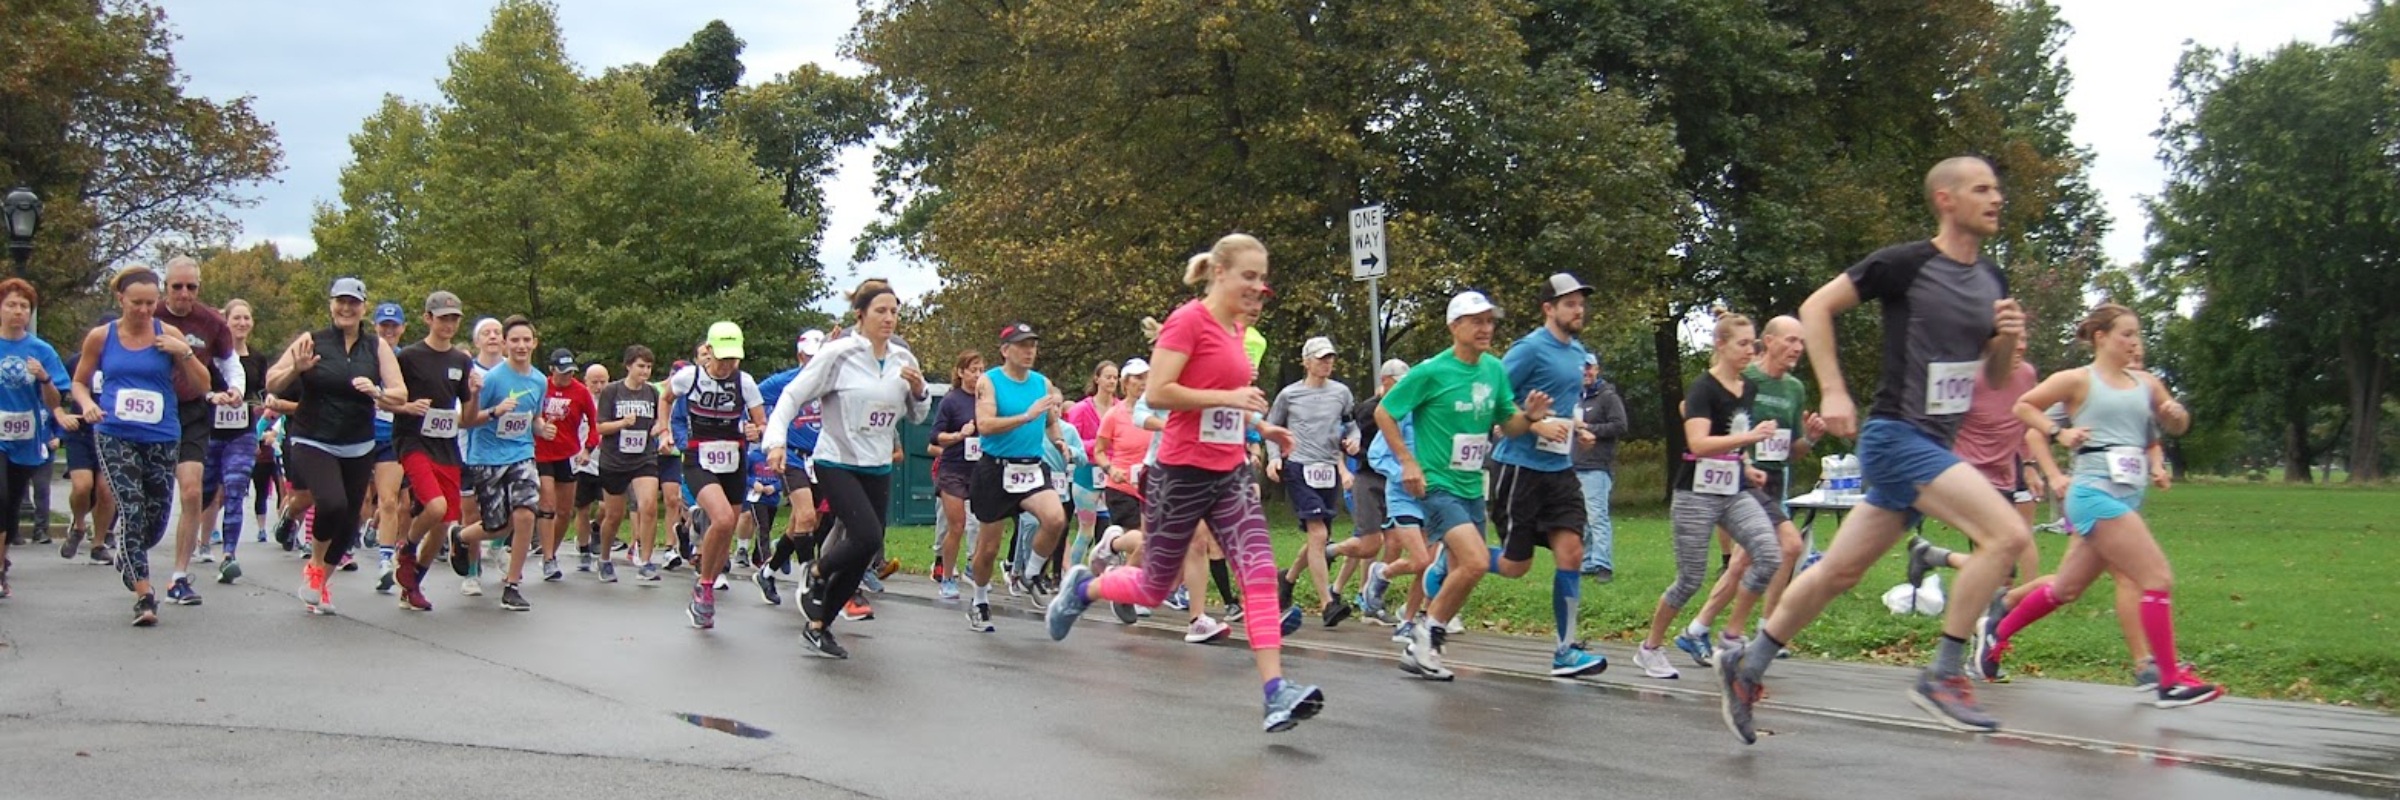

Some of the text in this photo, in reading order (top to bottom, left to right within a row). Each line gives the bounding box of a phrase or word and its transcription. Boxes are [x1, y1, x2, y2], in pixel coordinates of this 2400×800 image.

[1354, 210, 1378, 229] ONE
[1355, 231, 1379, 250] WAY
[125, 398, 155, 415] 953
[219, 411, 247, 422] 1014
[431, 417, 454, 431] 903
[870, 411, 895, 427] 937
[1212, 410, 1241, 431] 967
[4, 420, 30, 434] 999
[505, 418, 527, 432] 905
[625, 436, 643, 447] 934
[707, 450, 732, 465] 991
[1011, 472, 1036, 485] 973
[1703, 469, 1733, 485] 970
